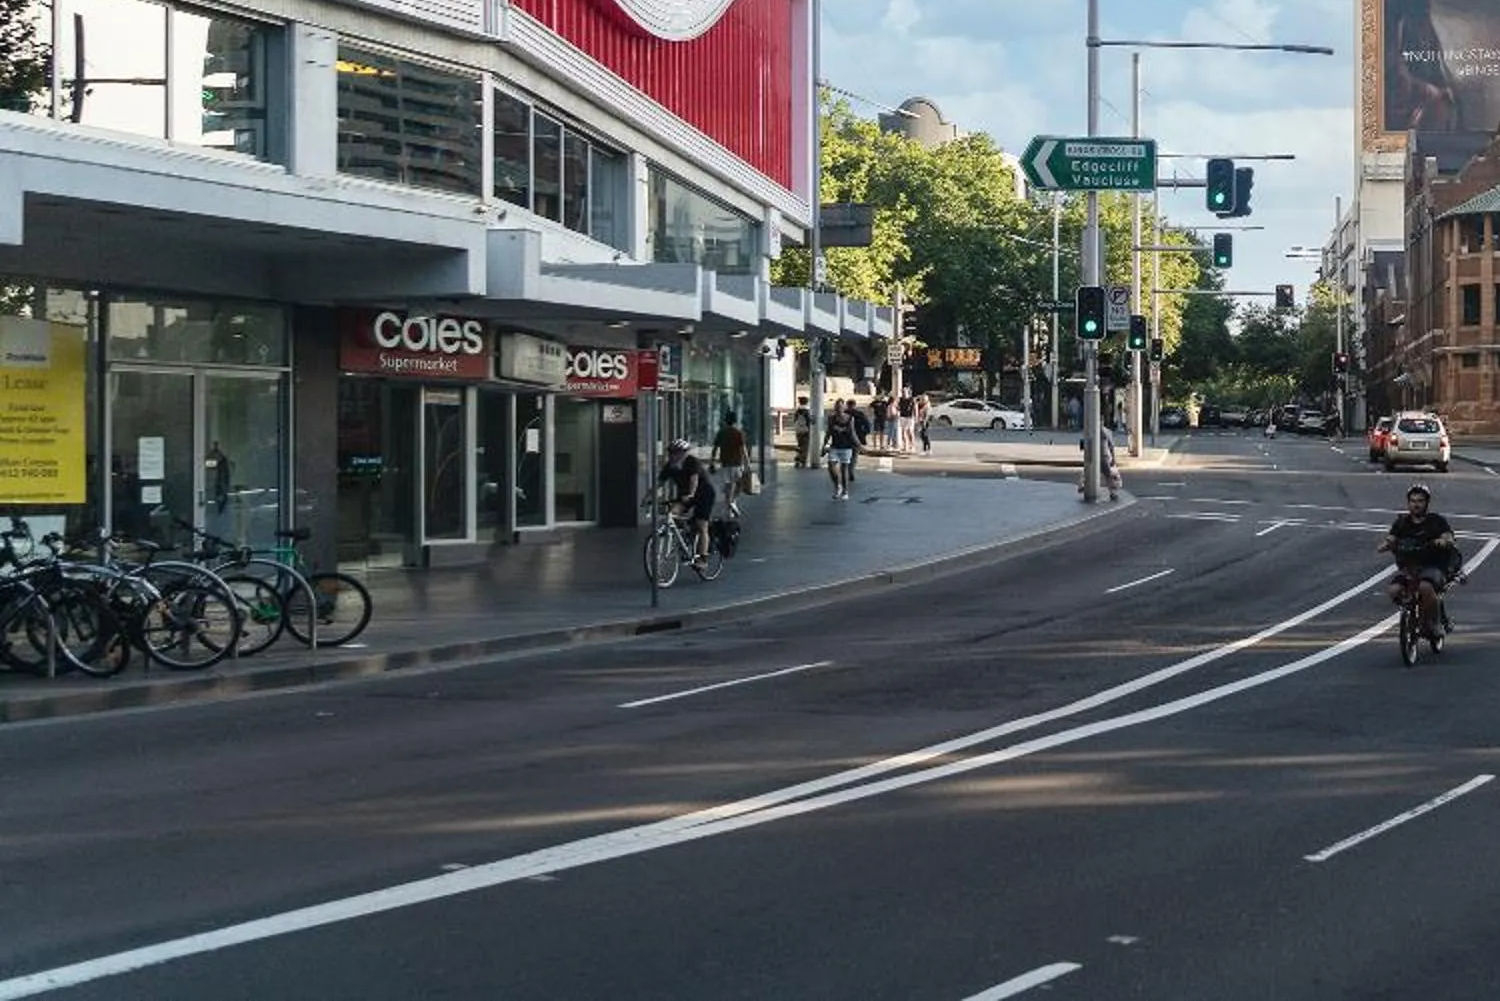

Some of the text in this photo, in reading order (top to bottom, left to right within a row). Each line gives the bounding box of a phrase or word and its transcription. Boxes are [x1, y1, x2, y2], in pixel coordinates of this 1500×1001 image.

[1071, 160, 1139, 174] Edgecliff
[1071, 174, 1140, 186] Vaucluse
[374, 312, 484, 354] coles
[379, 354, 459, 374] Supermarket
